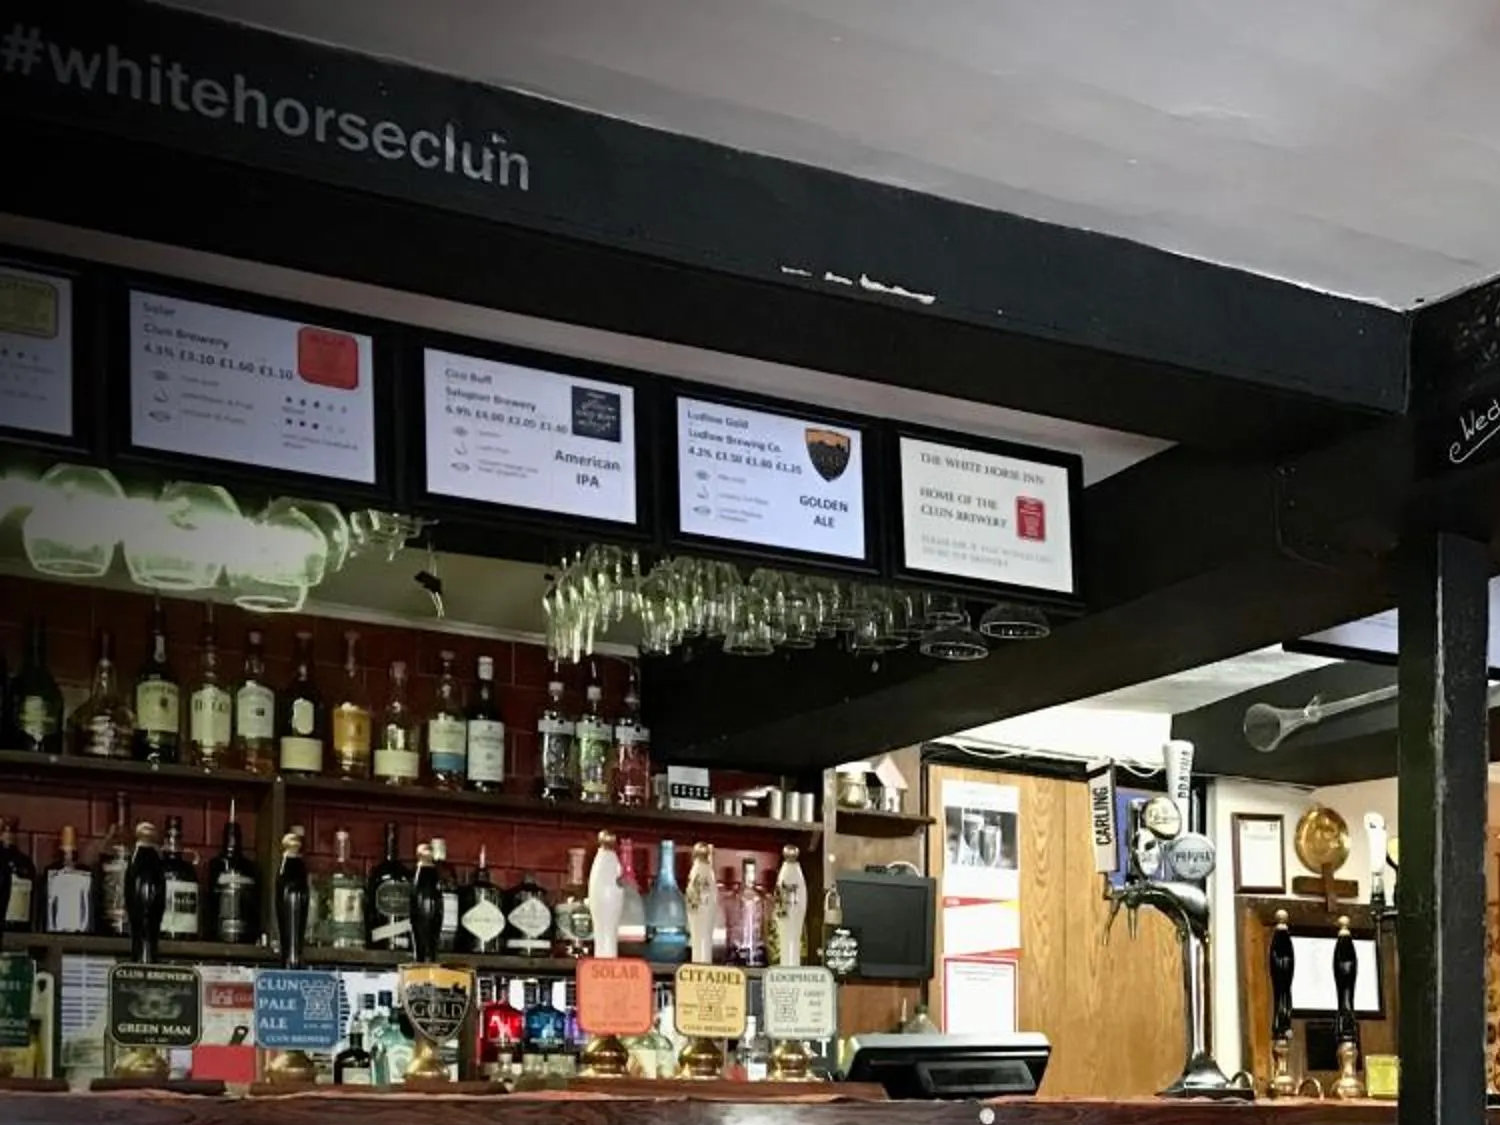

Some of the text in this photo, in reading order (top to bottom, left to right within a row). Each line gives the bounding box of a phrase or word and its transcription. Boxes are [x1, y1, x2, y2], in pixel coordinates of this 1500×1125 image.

[2, 24, 530, 192] #whitehorseclun
[726, 434, 766, 453] Brewing
[554, 449, 621, 471] American
[920, 453, 941, 466] THE
[945, 457, 982, 474] WHITE
[984, 465, 1020, 482] HORSE
[576, 474, 600, 489] IPA
[920, 487, 955, 503] HOME
[799, 496, 848, 513] GOLDEN
[813, 515, 835, 529] ALE
[956, 510, 1008, 529] BREWERY
[1093, 786, 1111, 846] CARLING
[591, 963, 640, 979] SOLAR
[679, 968, 741, 985] CITADEL
[257, 977, 299, 992] CLUN
[258, 997, 297, 1011] PALE
[117, 1023, 191, 1035] GREEN MAN
[259, 1016, 288, 1030] ALE
